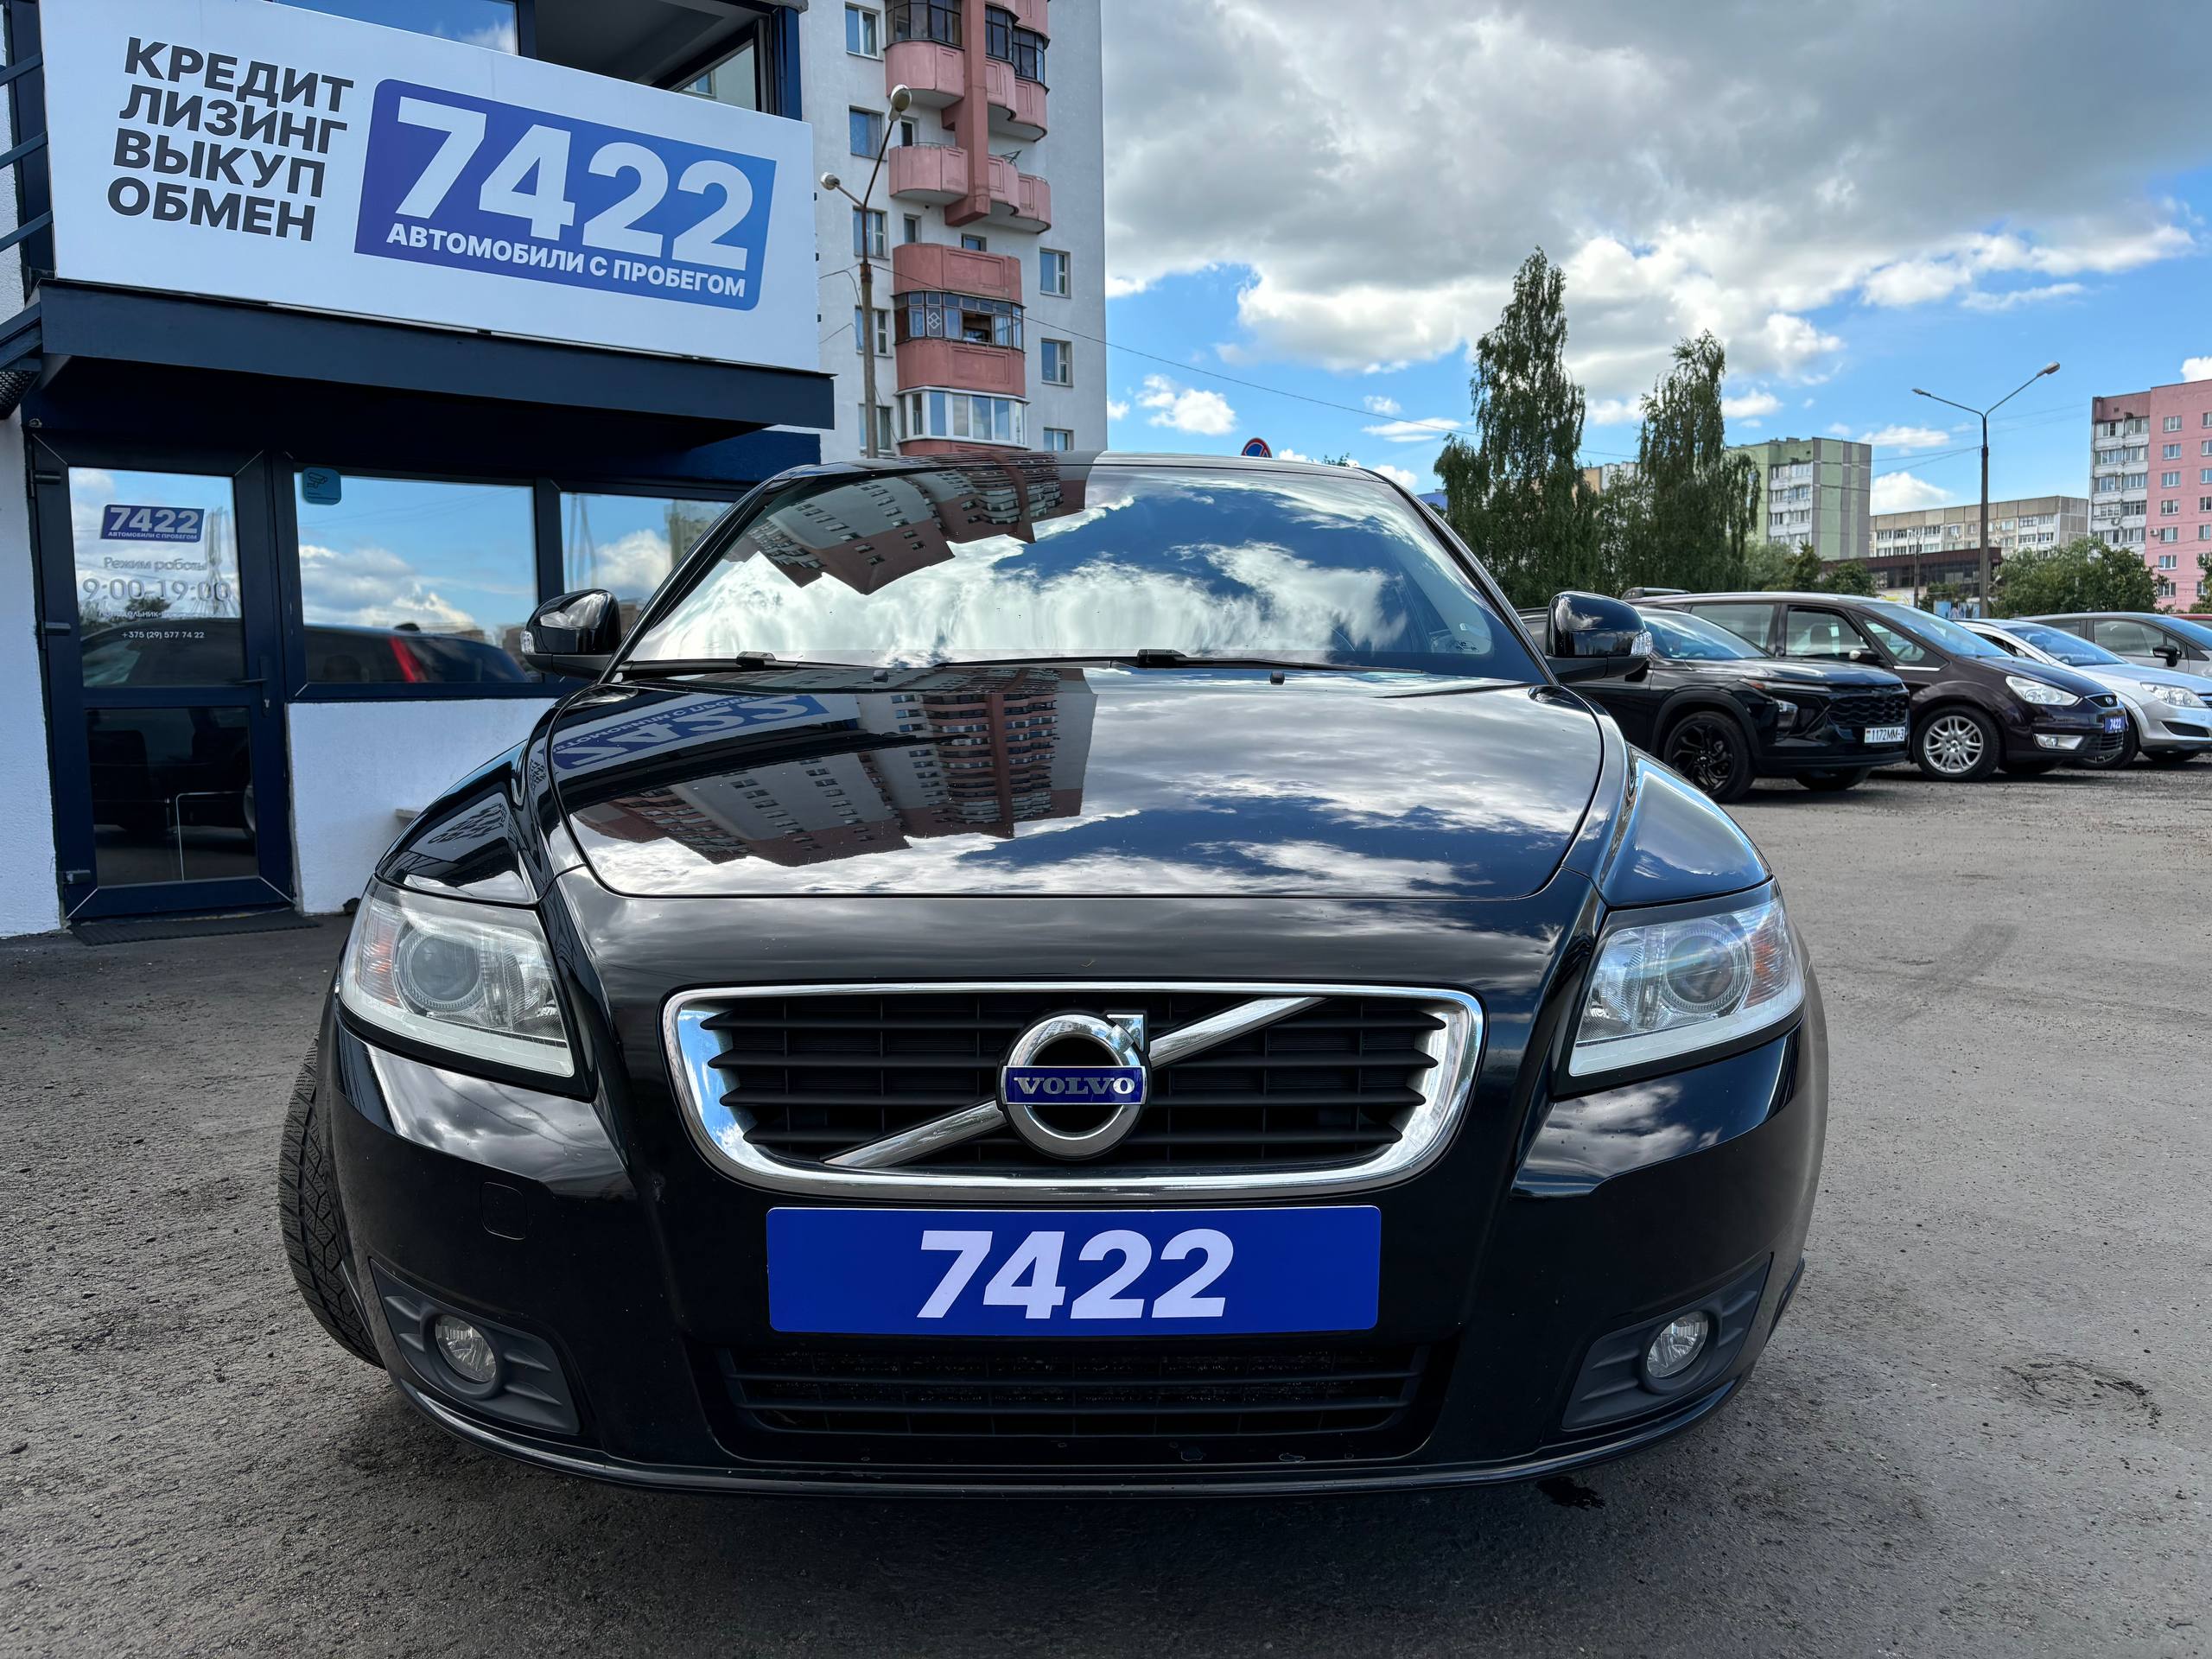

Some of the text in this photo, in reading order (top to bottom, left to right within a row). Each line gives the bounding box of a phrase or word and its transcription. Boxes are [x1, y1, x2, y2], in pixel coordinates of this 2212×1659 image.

[124, 36, 354, 112] КРЕДИТ
[118, 84, 348, 155] ЛИЗИНГ
[113, 128, 326, 199] ВЫКУП
[394, 96, 753, 271] 7422
[107, 176, 316, 242] ОБМЕН
[386, 222, 747, 298] АВТОМОБИЛИ С ПРОБЕГОМ
[110, 506, 199, 534] 7422
[104, 556, 152, 570] Режим
[146, 632, 162, 640] (29)
[1013, 1075, 1136, 1096] VOLVO
[916, 1228, 1235, 1319] 7422
